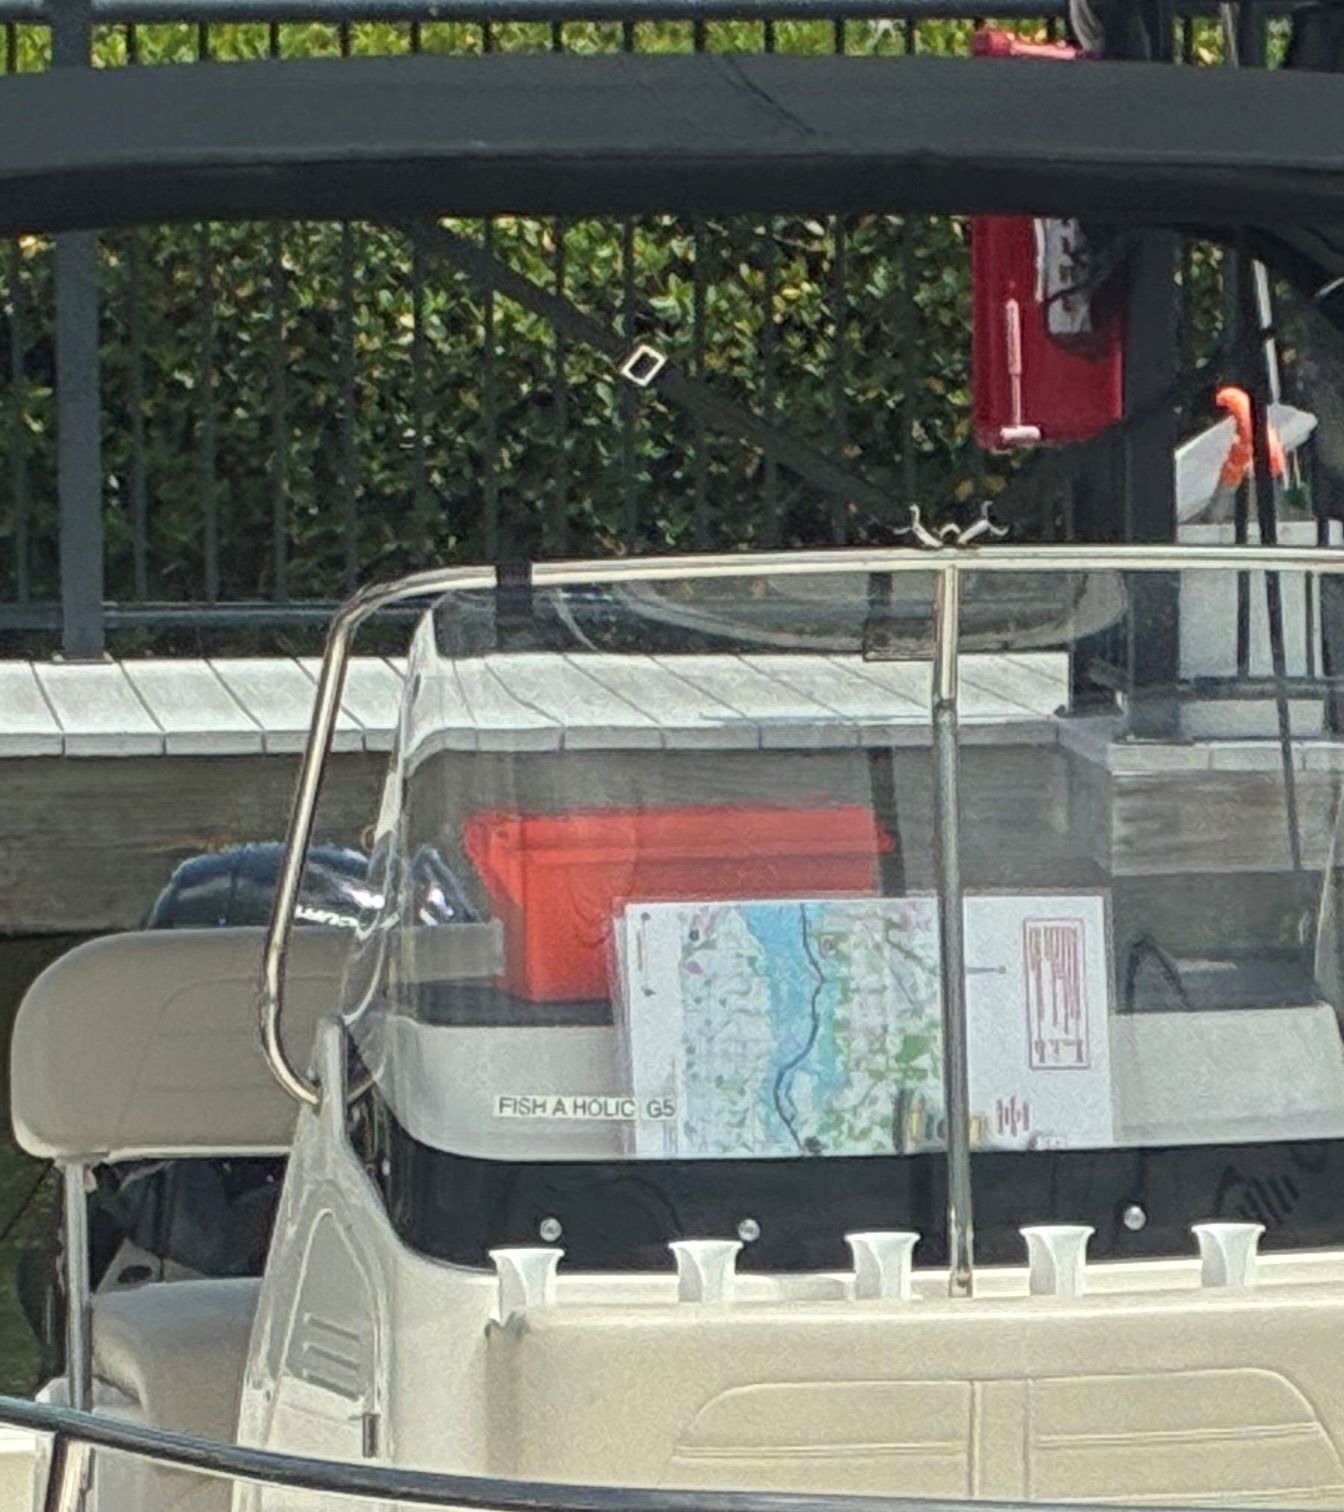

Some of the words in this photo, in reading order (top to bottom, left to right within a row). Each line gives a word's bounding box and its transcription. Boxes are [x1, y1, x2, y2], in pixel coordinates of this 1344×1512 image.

[498, 1097, 547, 1116] FISH
[552, 1098, 567, 1116] A
[572, 1099, 635, 1118] HOLIC
[646, 1100, 676, 1119] G5
